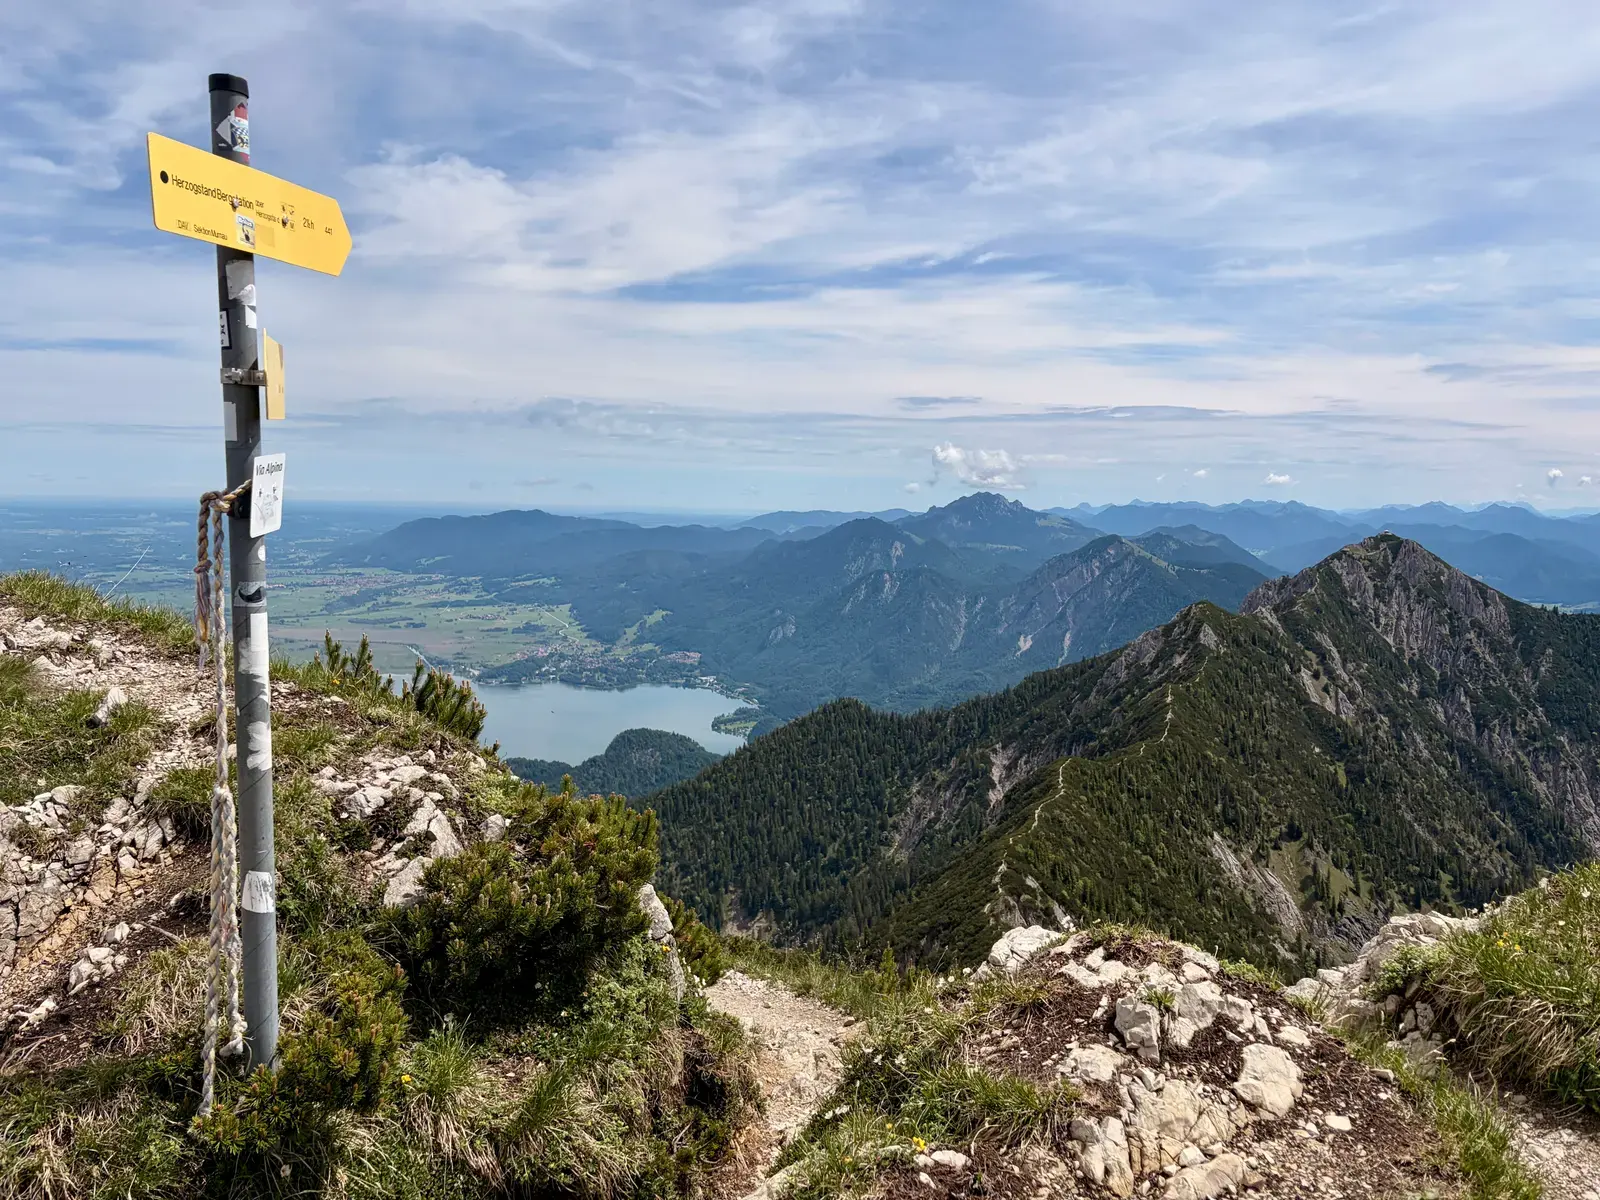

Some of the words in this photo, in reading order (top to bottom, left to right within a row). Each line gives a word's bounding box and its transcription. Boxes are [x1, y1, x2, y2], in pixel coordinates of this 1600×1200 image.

[171, 173, 217, 199] Herzogstand
[217, 188, 254, 210] Bergtation
[193, 224, 210, 236] Sektion
[256, 464, 265, 476] Via
[265, 462, 283, 475] Alpina
